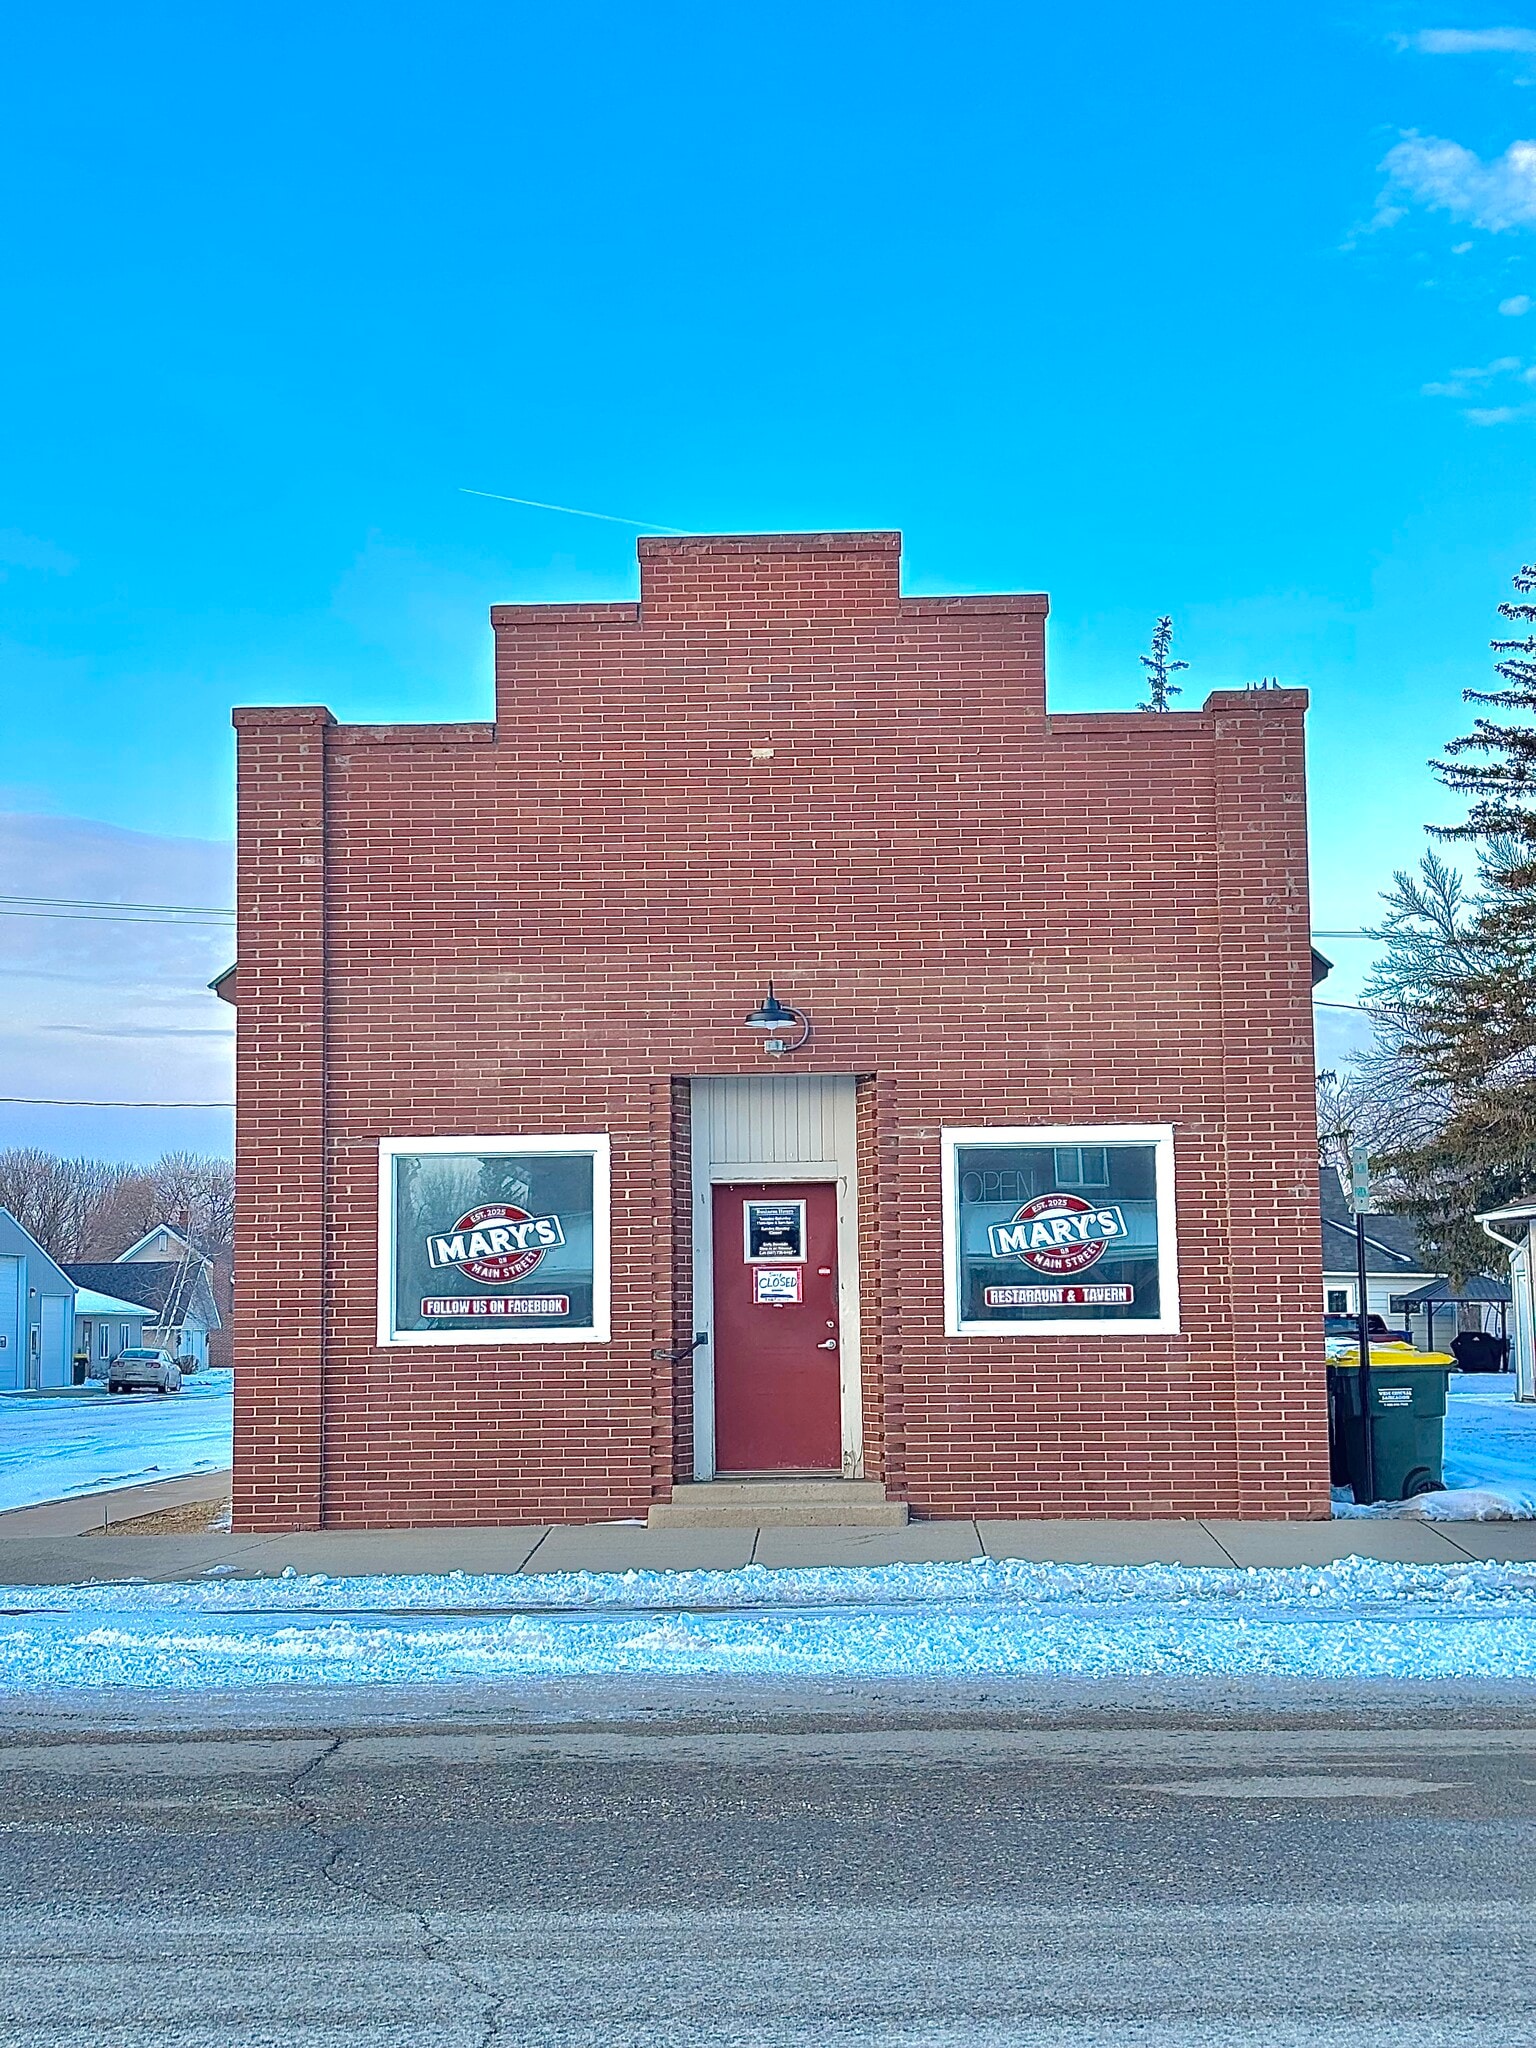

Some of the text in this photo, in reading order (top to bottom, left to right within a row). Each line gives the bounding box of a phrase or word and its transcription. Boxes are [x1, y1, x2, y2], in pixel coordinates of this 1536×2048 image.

[962, 1170, 1034, 1203] OPEN
[470, 1208, 507, 1223] EST. 2025
[1031, 1199, 1068, 1213] EST. 2025
[435, 1220, 556, 1263] MARY'S
[996, 1211, 1119, 1253] MARY'S
[471, 1251, 538, 1278] MAIN STREET
[1033, 1241, 1100, 1269] MAIN STREET
[759, 1276, 797, 1288] CLOSED
[427, 1299, 563, 1314] FOLLOW US ON FACEBOOK
[990, 1288, 1127, 1304] RESTARAUNT & TAVERN
